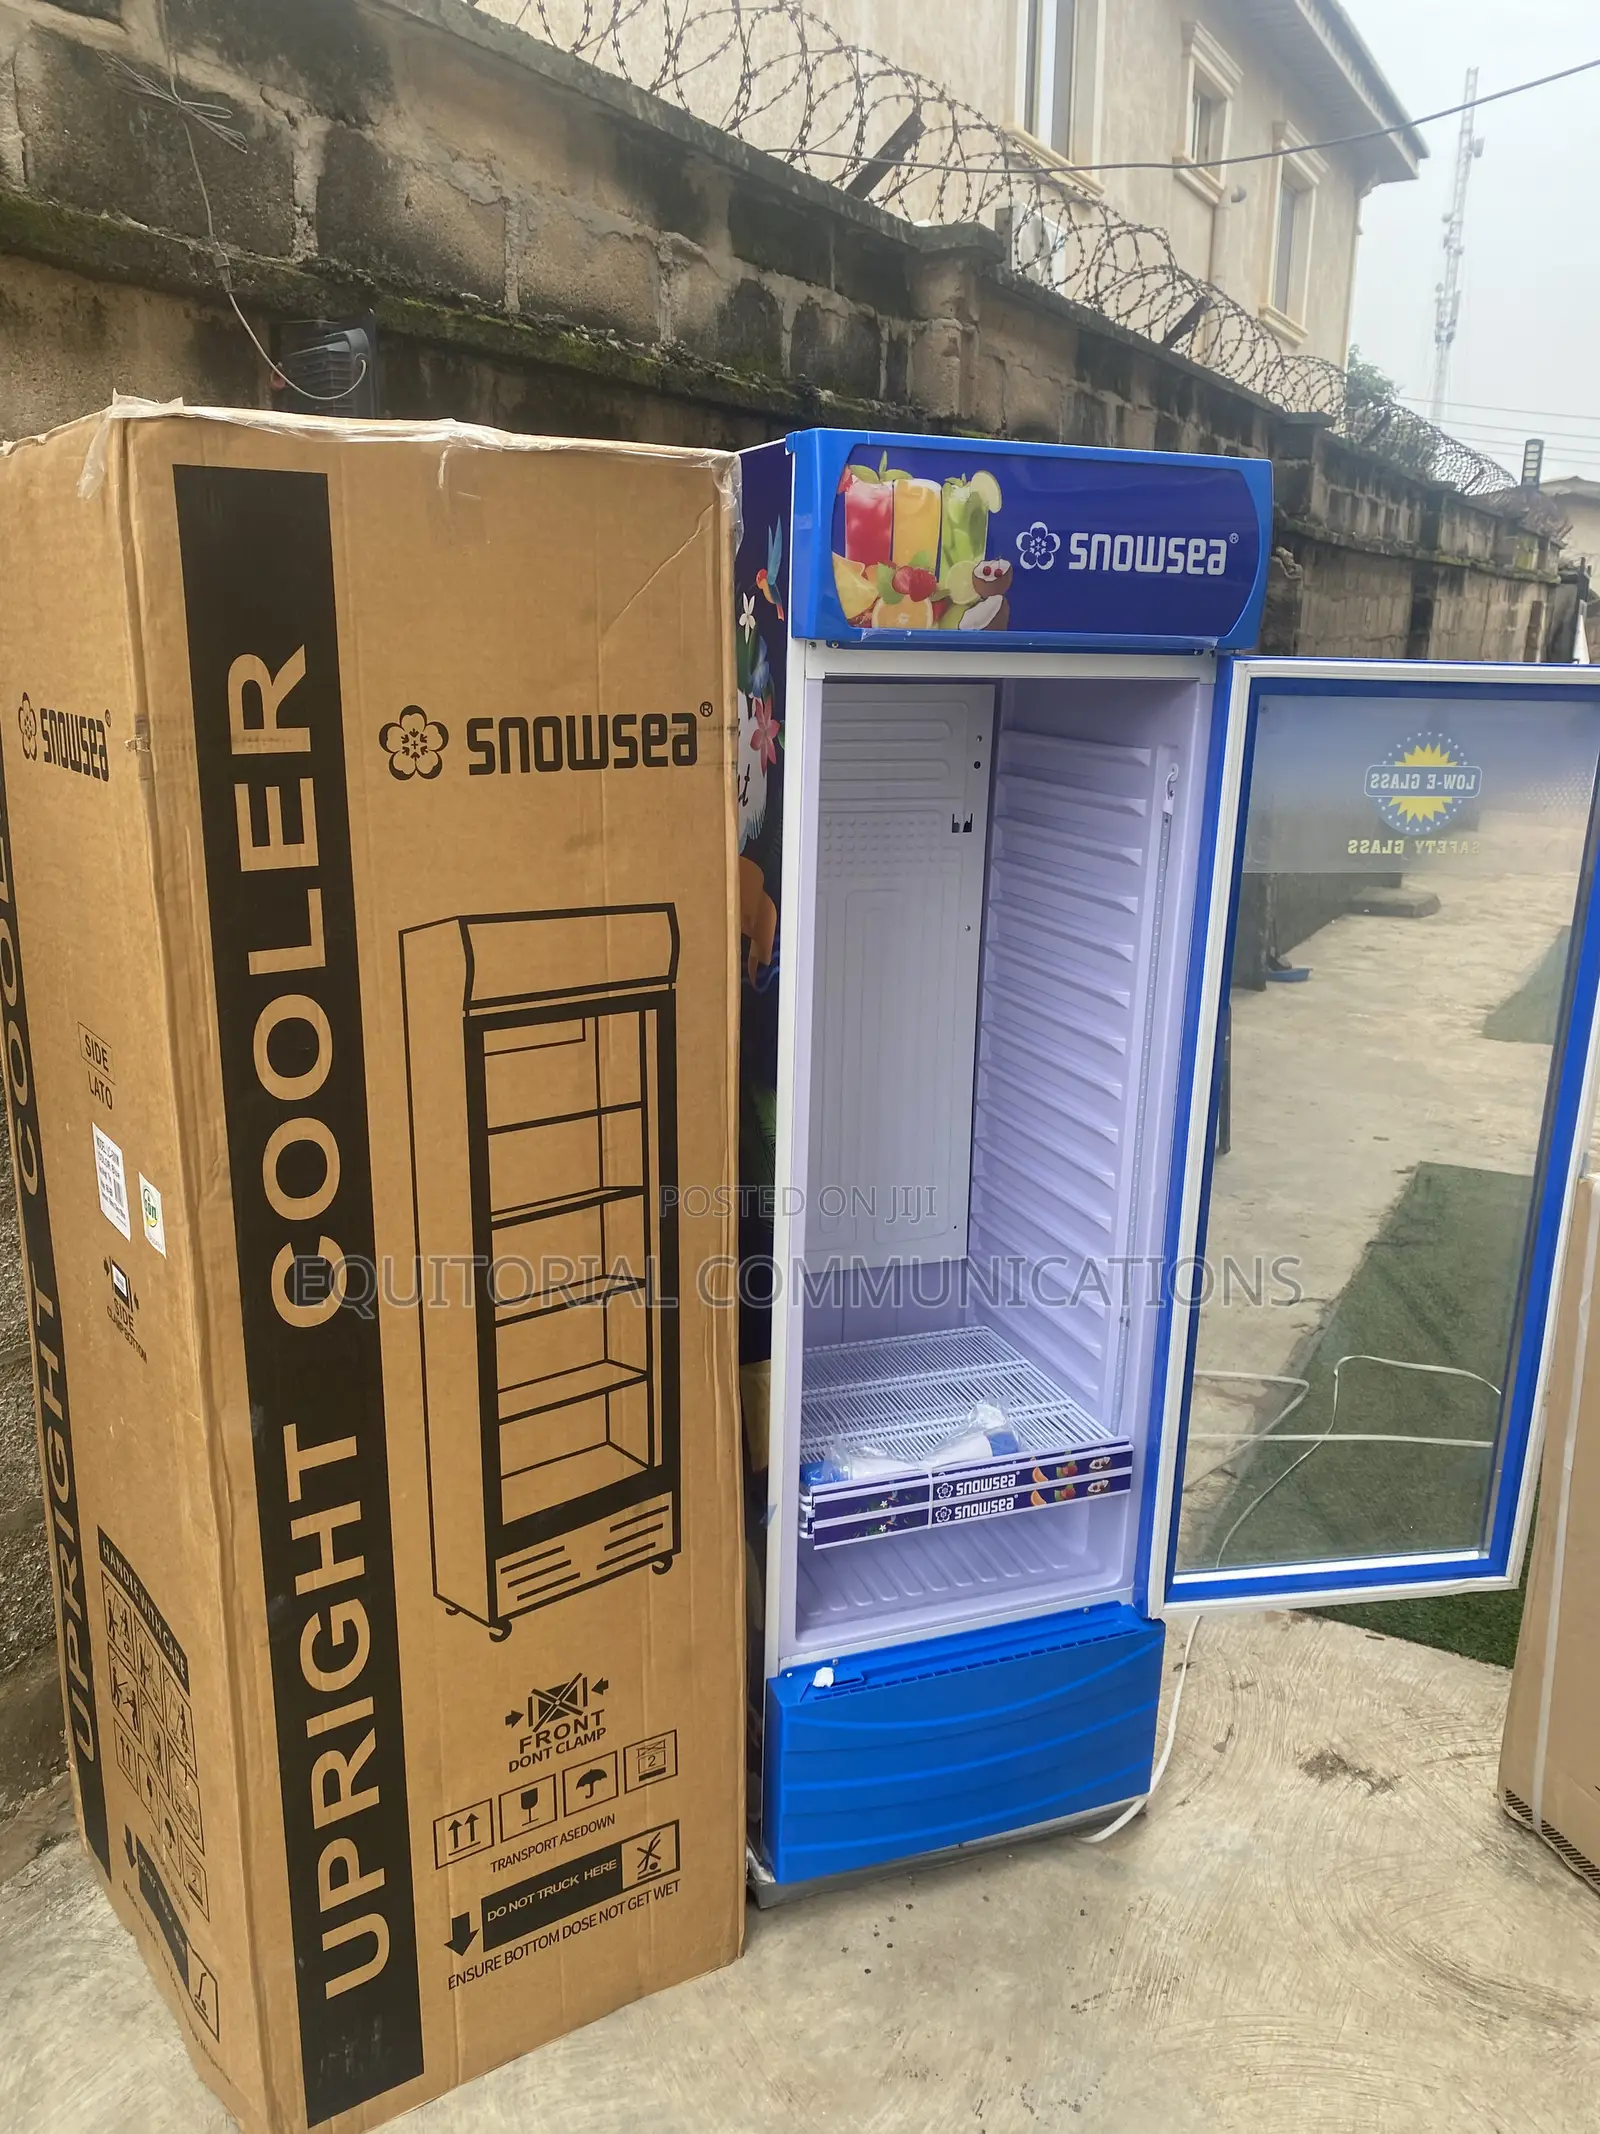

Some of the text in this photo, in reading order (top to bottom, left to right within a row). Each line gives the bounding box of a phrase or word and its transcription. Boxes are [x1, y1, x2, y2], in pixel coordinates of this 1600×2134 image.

[84, 1034, 109, 1073] SIDE
[88, 1070, 113, 1110] LATO
[113, 1298, 135, 1334] SIDE
[227, 644, 390, 2000] UPRIGHT COOLER
[102, 1541, 186, 1679] HANDLE WITH CARE
[508, 1727, 606, 1773] DONT CLAMP
[519, 1708, 605, 1755] FRONT
[648, 1755, 656, 1768] 2
[490, 1813, 616, 1873] TRANSPORT ASEDOWN
[487, 1859, 618, 1922] DO NOT TRUCK HERE
[448, 1878, 681, 1991] ENSURE BOTTOM DOSE NOT GET WET
